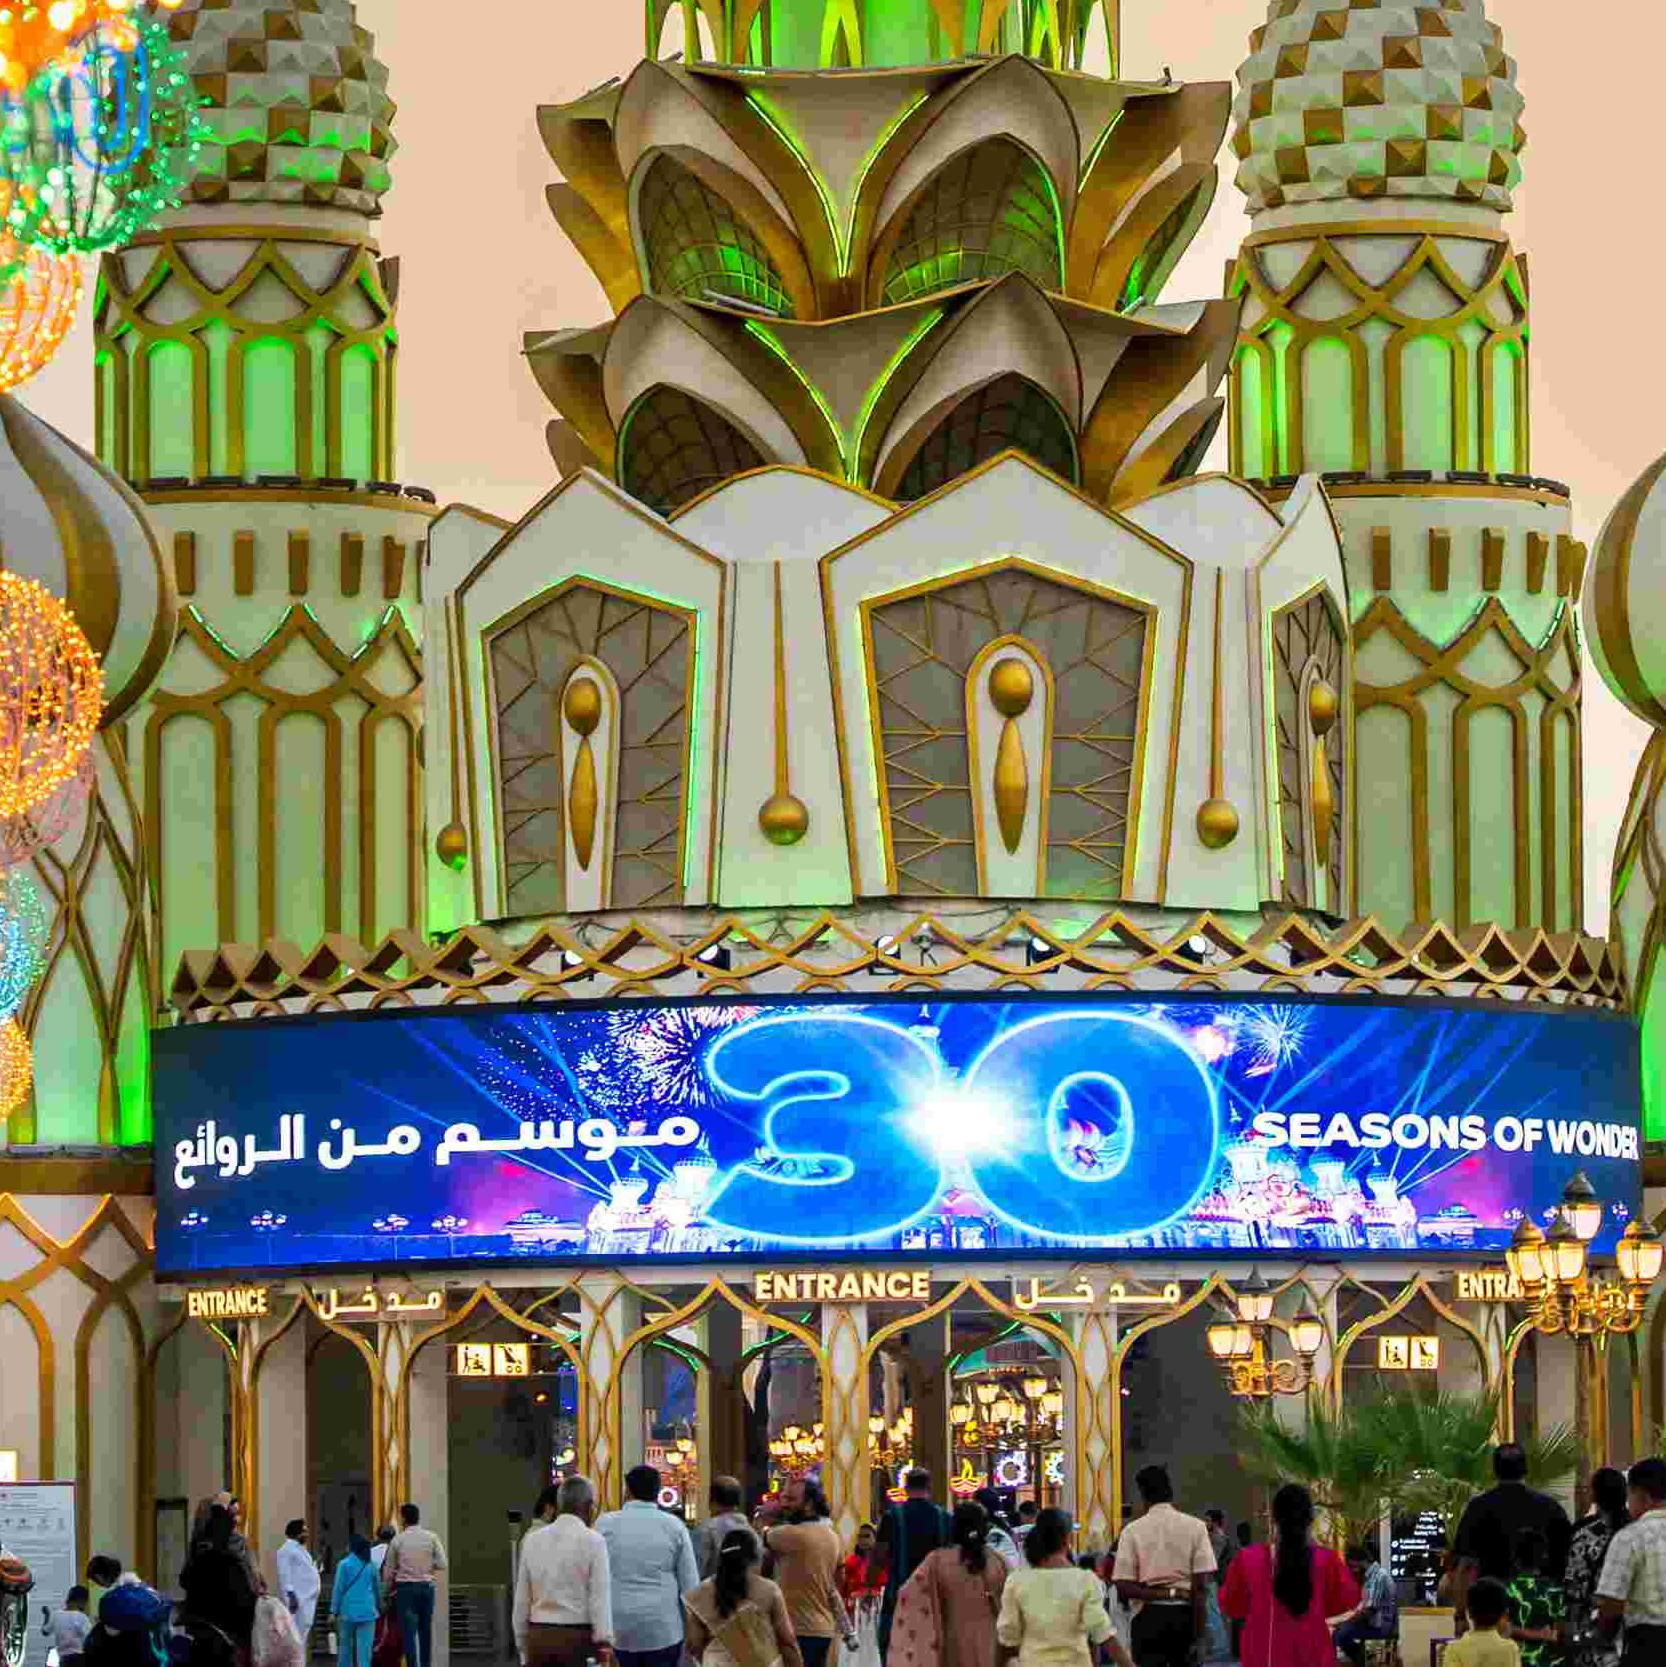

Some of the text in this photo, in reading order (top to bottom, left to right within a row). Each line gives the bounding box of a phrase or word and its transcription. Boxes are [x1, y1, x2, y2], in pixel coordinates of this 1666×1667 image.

[318, 1118, 421, 1170] من
[699, 1010, 1219, 1245] 30
[1251, 1112, 1640, 1161] SEASONS OF WONDER
[174, 1113, 306, 1190] الروائع
[188, 1287, 269, 1318] ENTRANCE
[318, 1285, 442, 1320] مدخل
[754, 1270, 930, 1301] ENTRANCE
[1014, 1276, 1182, 1310] مدخل
